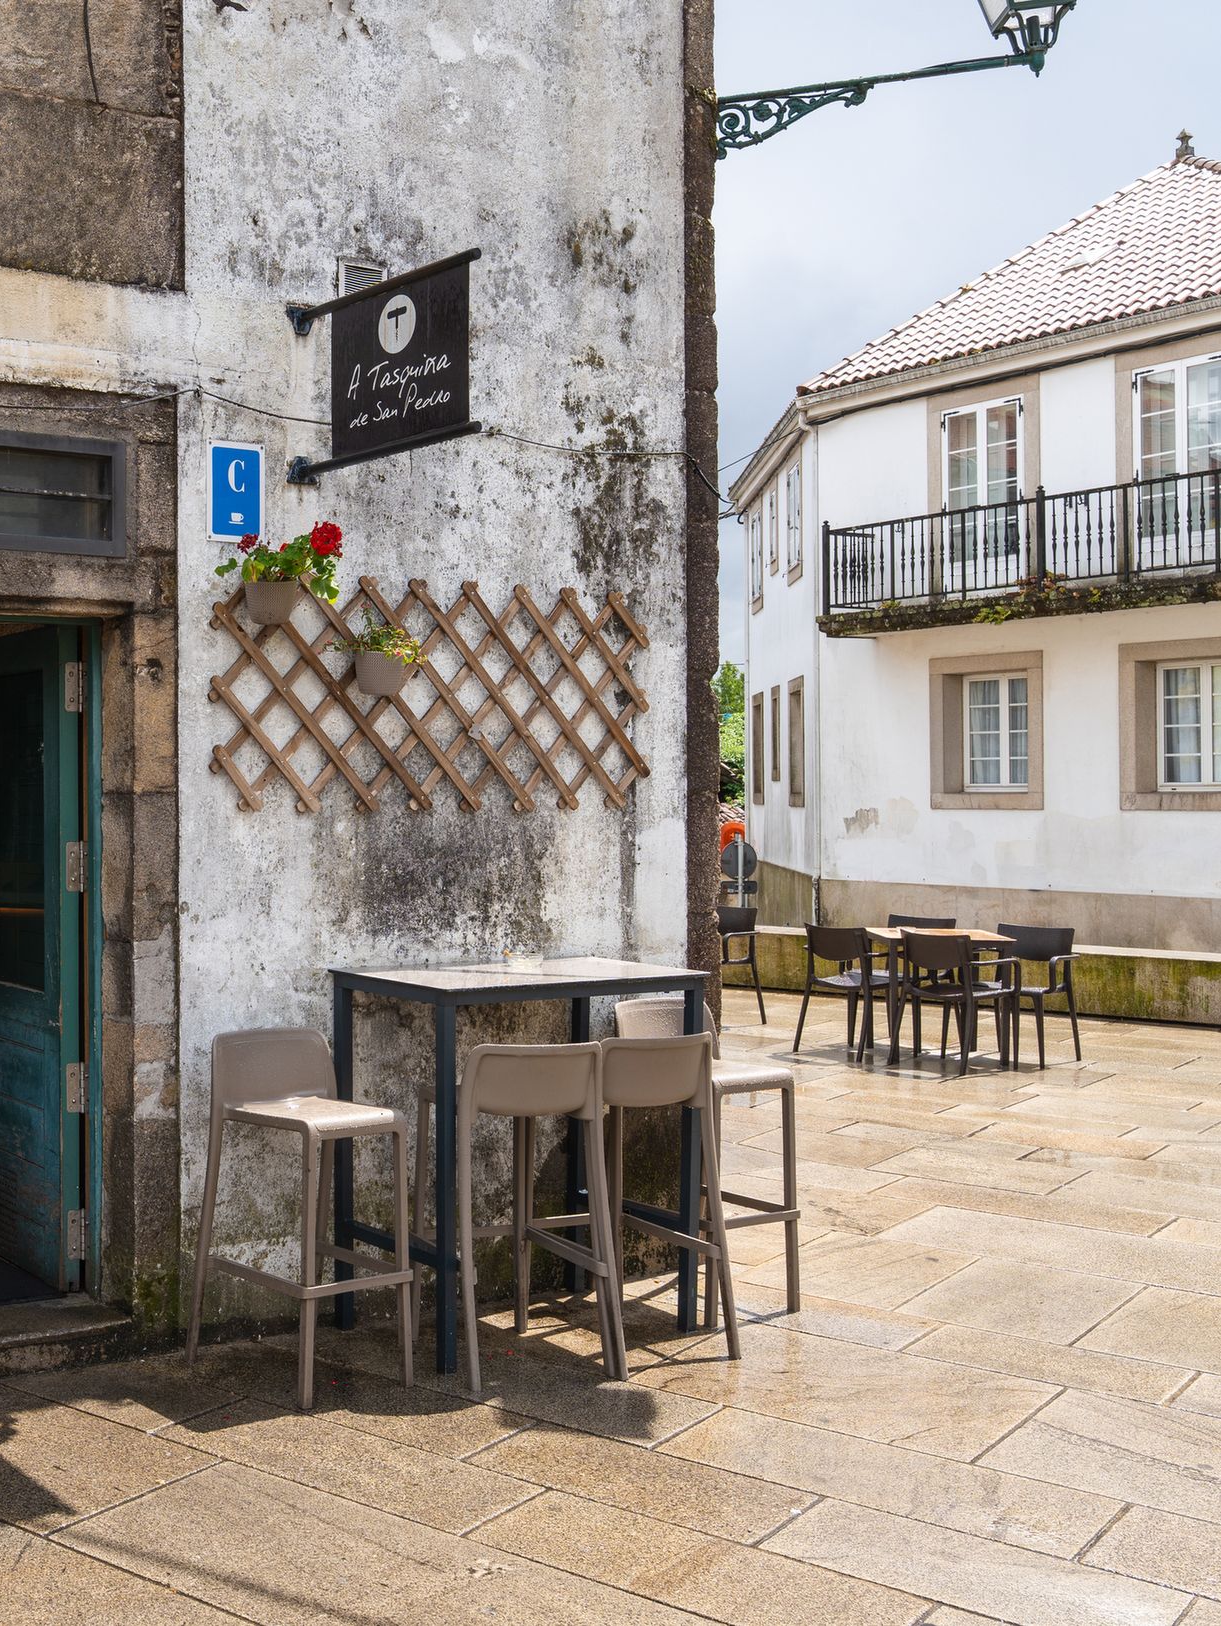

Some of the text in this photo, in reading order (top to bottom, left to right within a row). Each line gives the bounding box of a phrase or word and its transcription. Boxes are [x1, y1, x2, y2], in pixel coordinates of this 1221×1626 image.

[347, 363, 361, 400] A
[349, 382, 451, 429] de San Pedro
[227, 459, 246, 493] C
